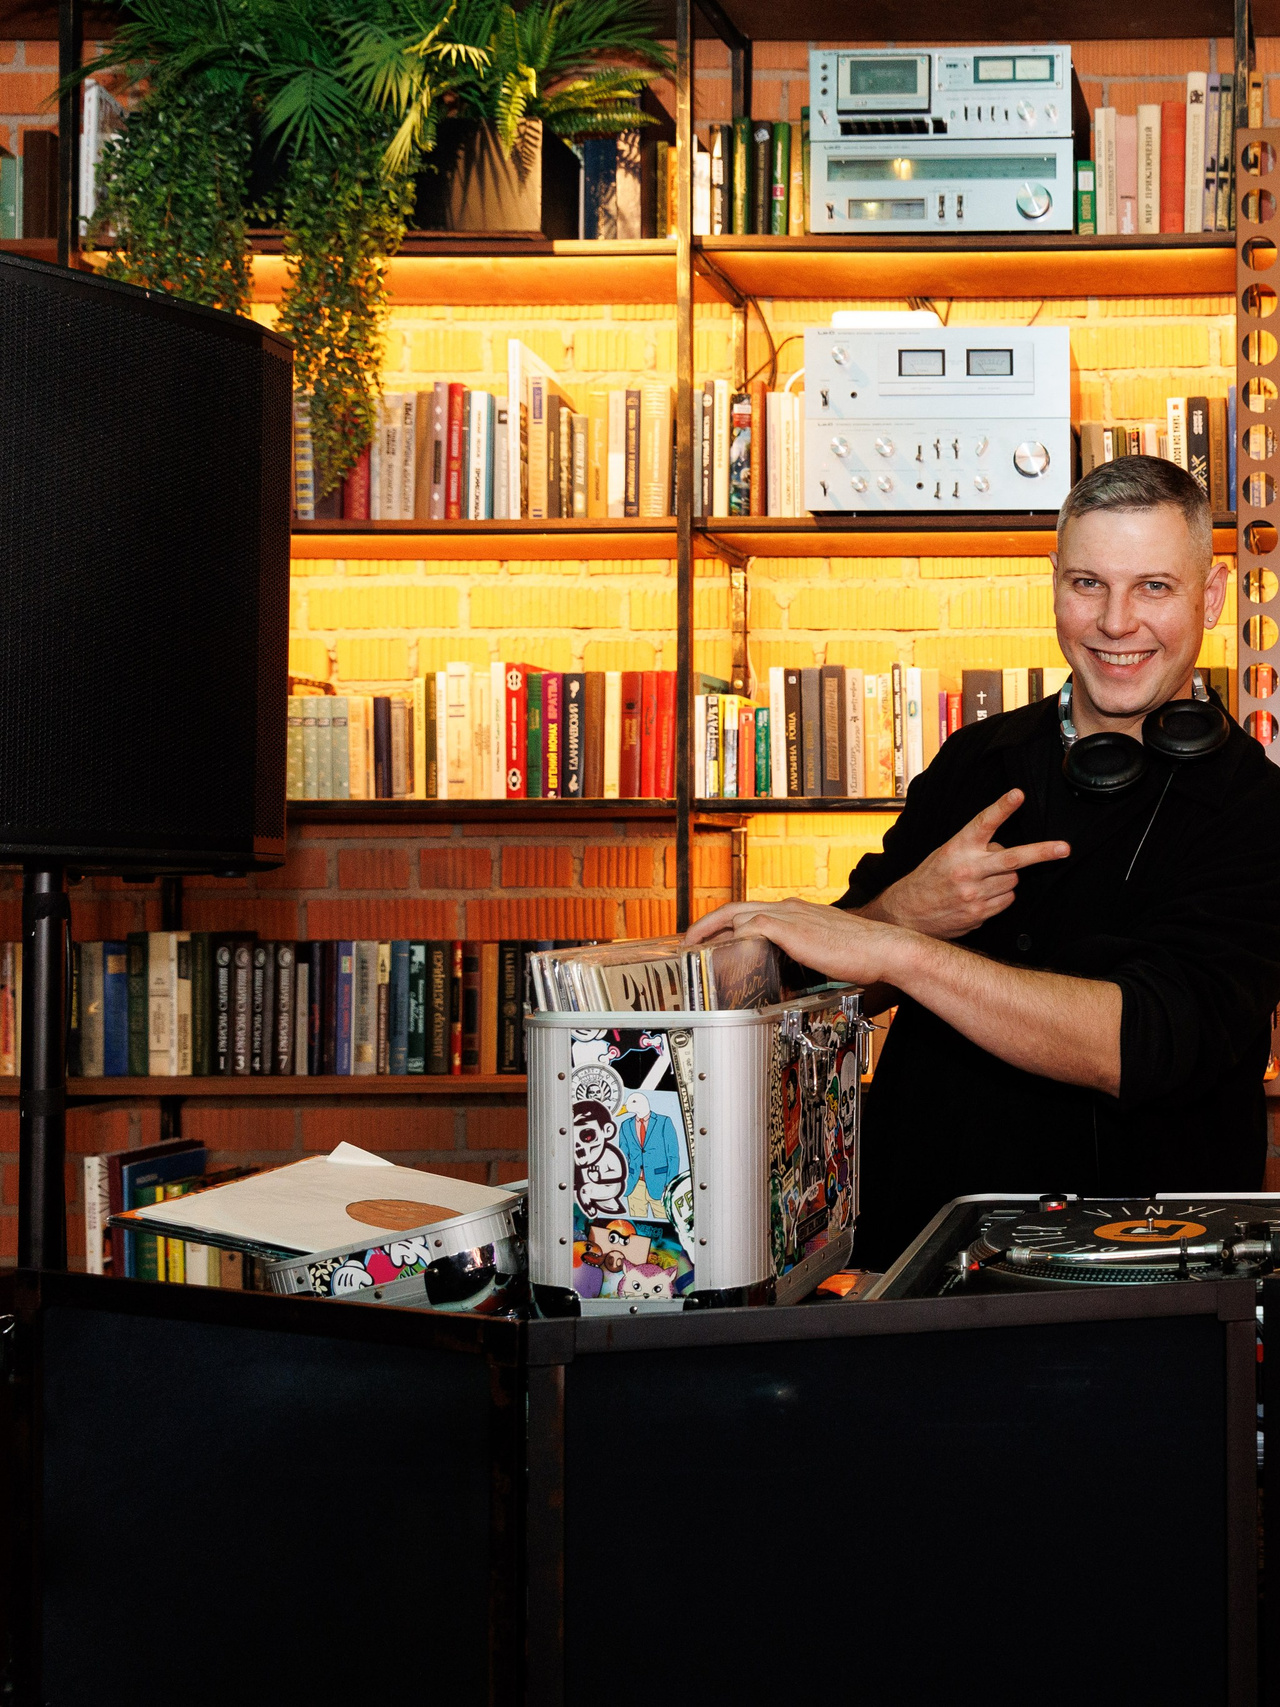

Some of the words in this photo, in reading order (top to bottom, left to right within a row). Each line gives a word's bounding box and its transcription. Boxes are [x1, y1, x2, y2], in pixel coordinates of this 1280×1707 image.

[1143, 126, 1153, 200] ПРИКЛЮЧЕНИЙ
[1144, 203, 1153, 225] МИР
[547, 677, 558, 720] БРАТВА
[547, 722, 558, 752] МОНАХ
[708, 705, 719, 740] ТРАУБ
[788, 711, 797, 740] РОЩА
[547, 752, 558, 788] ЕВГЕНИЙ
[790, 744, 798, 791] МАРЬИНА
[432, 950, 445, 1011] АСТАФЬЕВ
[433, 1012, 446, 1058] ВИКТОР
[219, 1056, 225, 1070] 1
[234, 1054, 245, 1071] 3
[251, 1056, 261, 1071] 4
[278, 1055, 288, 1069] 7
[681, 1086, 690, 1111] ONE
